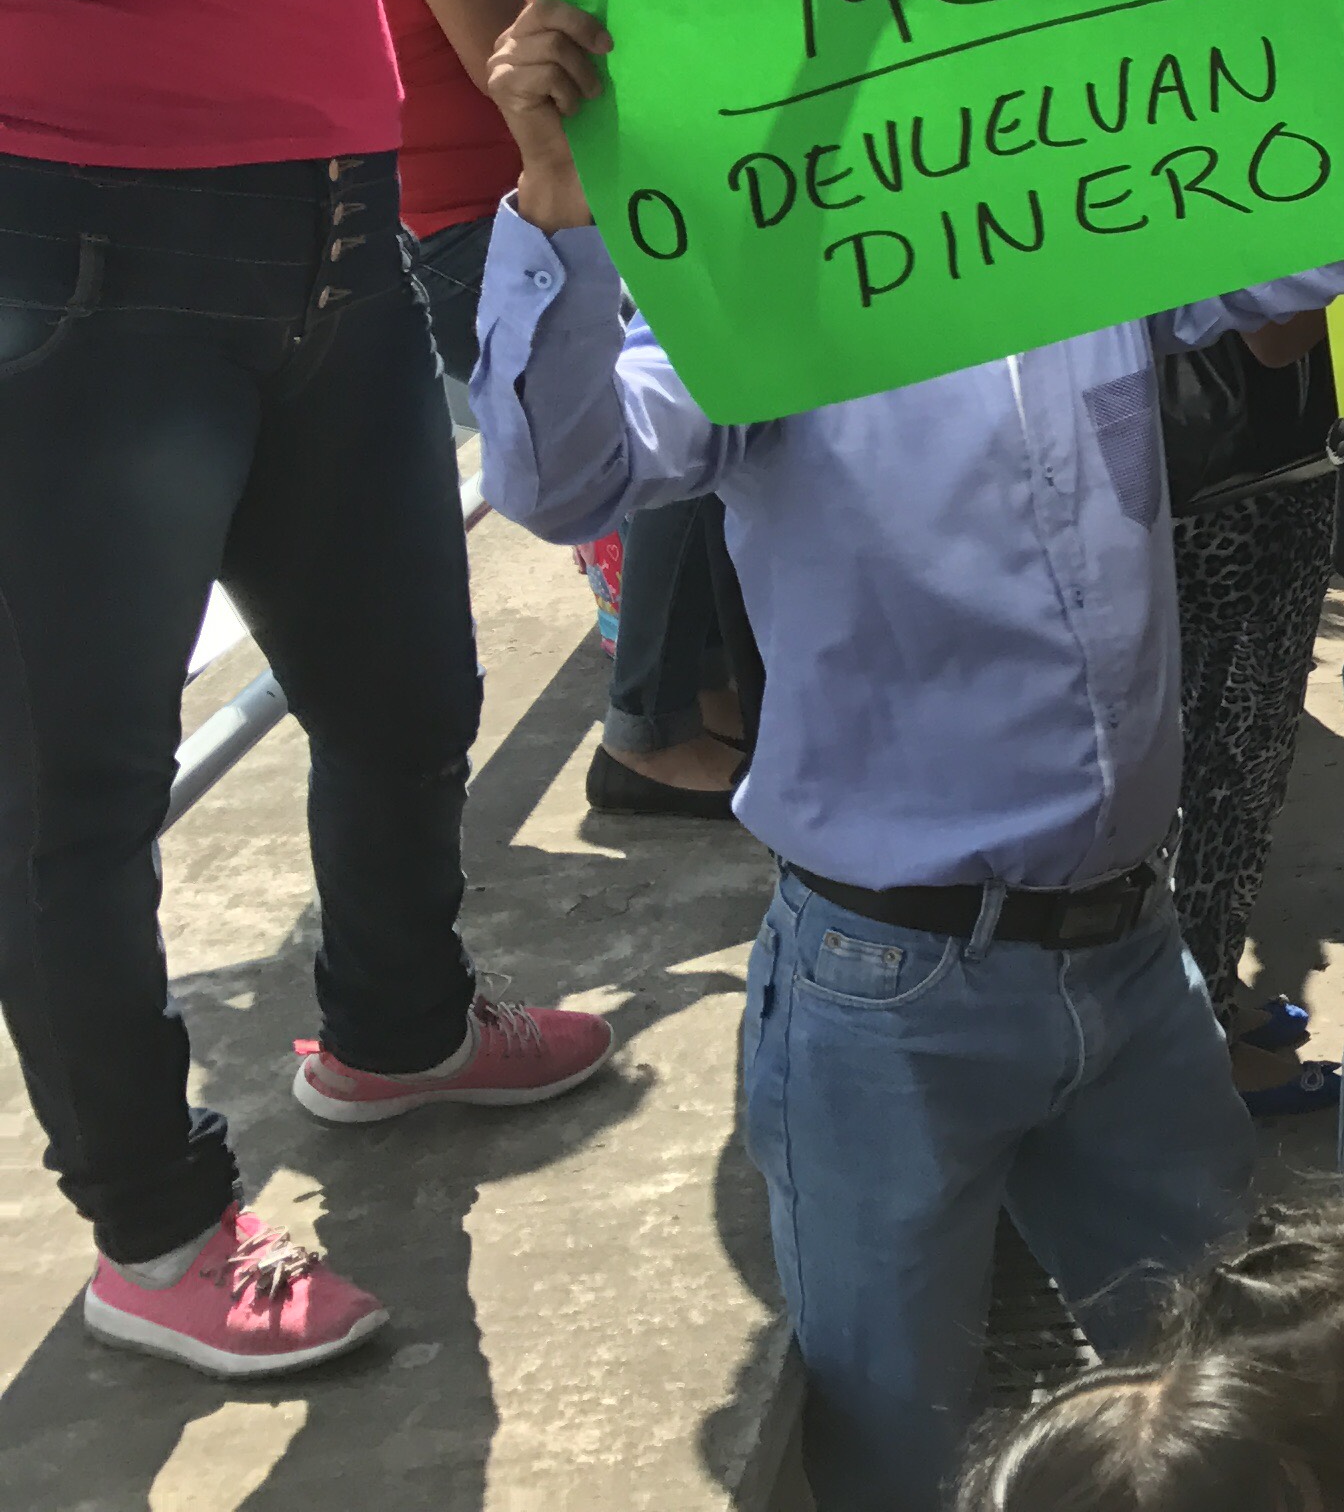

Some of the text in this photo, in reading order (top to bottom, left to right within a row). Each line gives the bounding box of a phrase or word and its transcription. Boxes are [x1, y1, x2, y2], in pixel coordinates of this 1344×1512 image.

[627, 188, 688, 261] O
[728, 35, 1277, 232] DEVUELVAN
[824, 122, 1332, 308] DINERO
